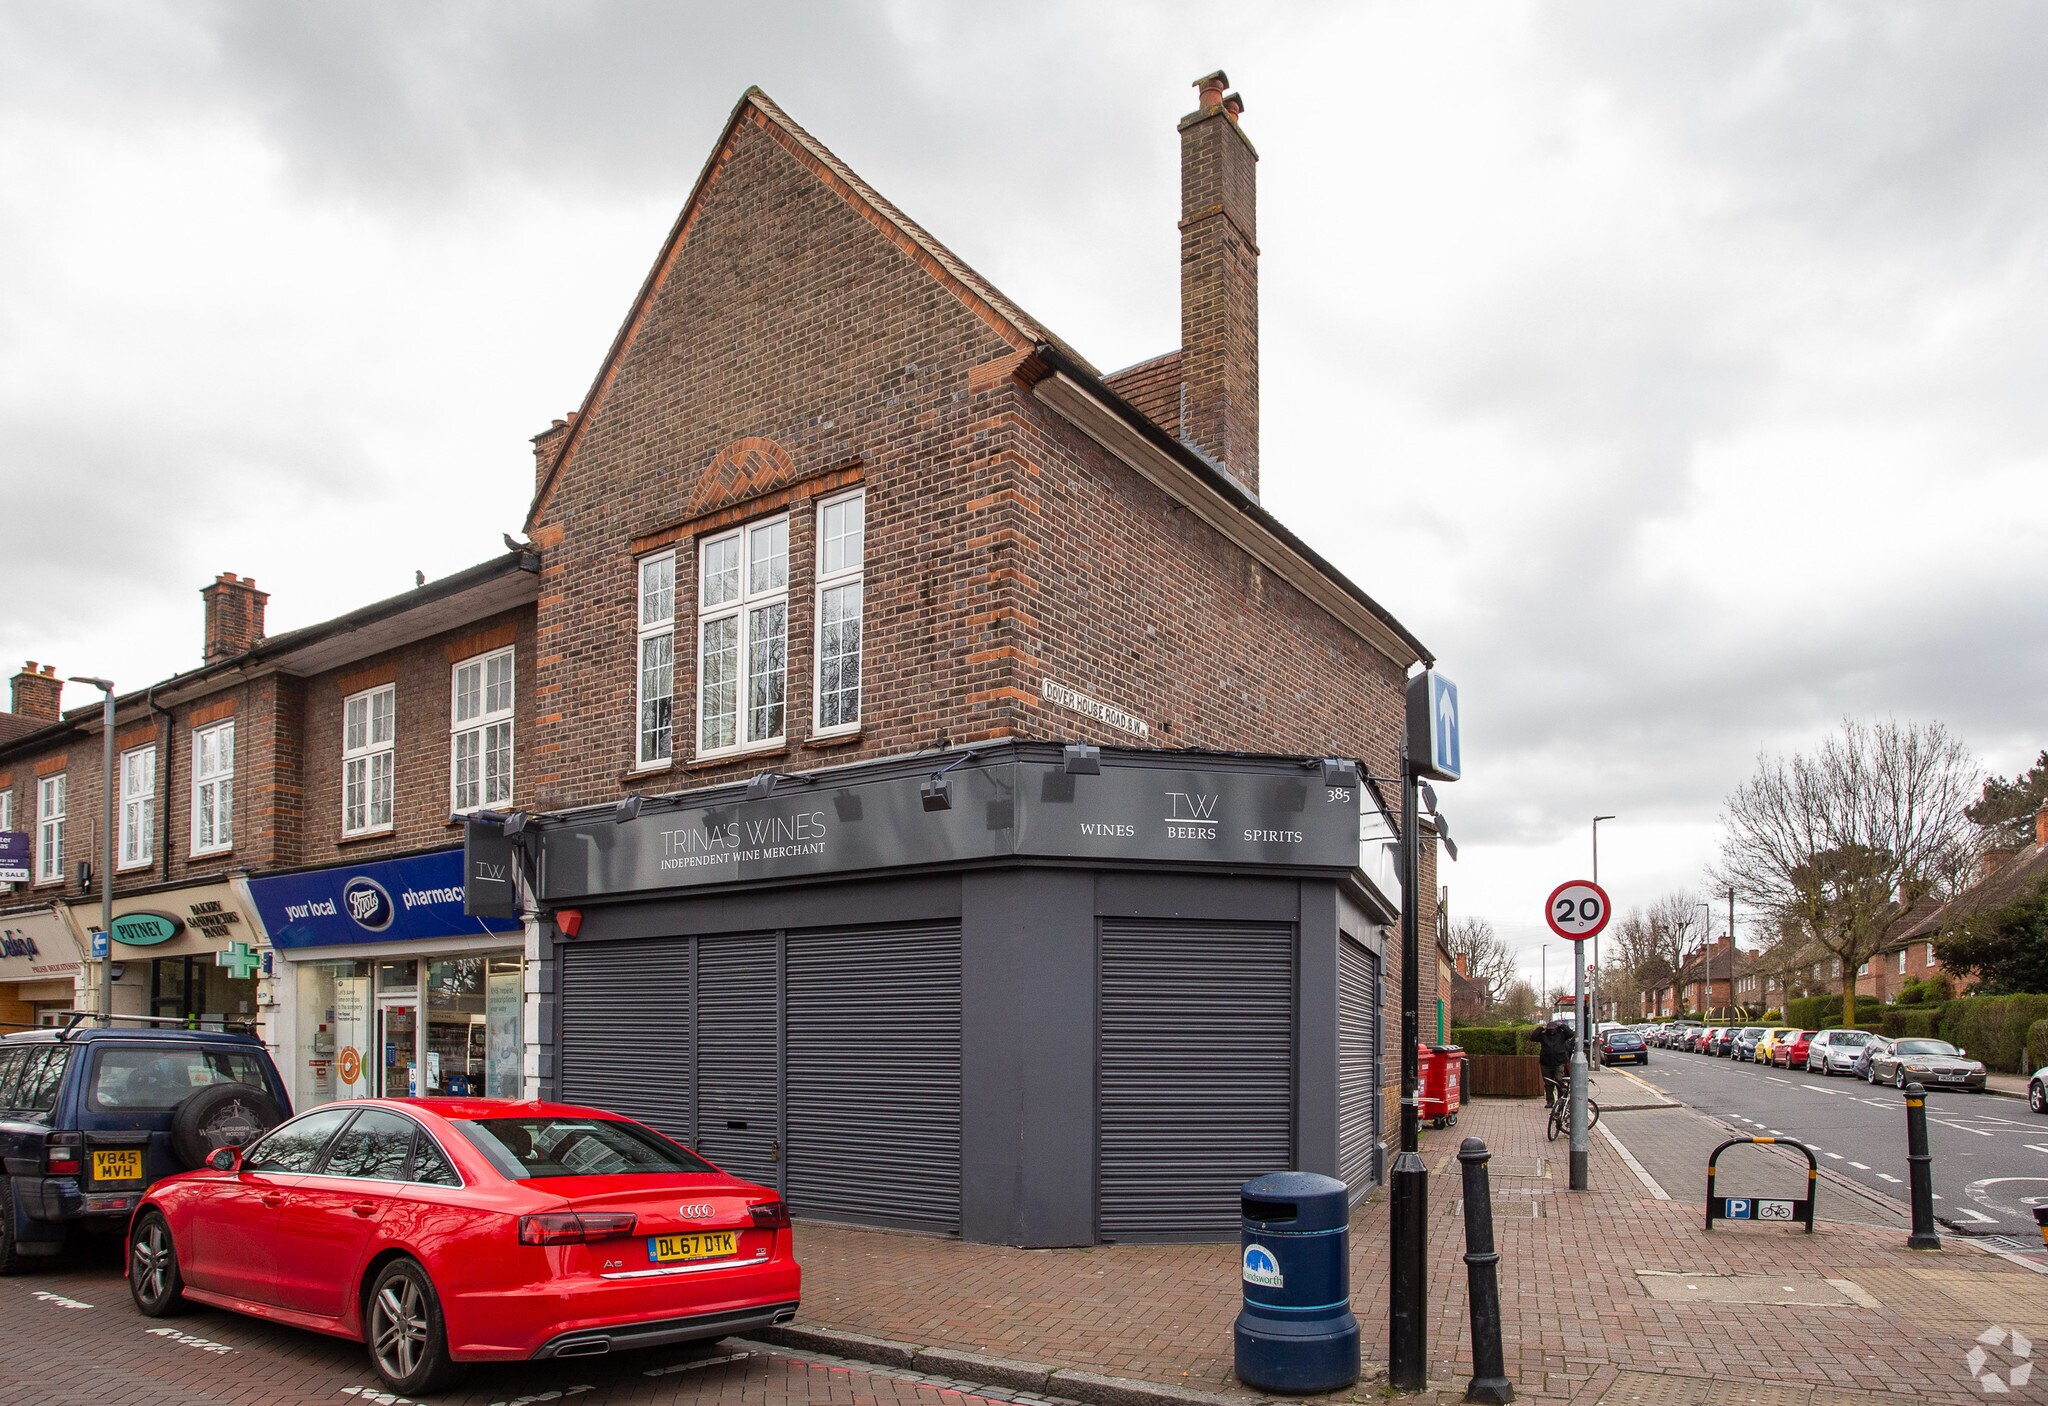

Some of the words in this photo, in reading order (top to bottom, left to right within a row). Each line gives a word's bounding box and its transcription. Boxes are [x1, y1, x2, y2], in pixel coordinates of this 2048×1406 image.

[1046, 683, 1074, 708] DOVER
[1076, 696, 1104, 719] HOUSE
[1327, 788, 1350, 803] 385
[1165, 792, 1219, 819] TW
[660, 822, 741, 855] TRINA'S
[745, 811, 826, 845] WINES
[1080, 823, 1135, 837] WINES
[1167, 826, 1216, 840] BEERS
[1244, 829, 1303, 843] SPIRITS
[661, 852, 730, 870] INDEPENDENT
[732, 849, 760, 862] WINE
[763, 842, 826, 859] MERCHANT
[476, 861, 506, 880] TW
[189, 900, 222, 915] BAKERY
[285, 903, 309, 922] your
[309, 898, 337, 917] local
[350, 889, 379, 919] Boots
[1556, 898, 1600, 922] 20
[186, 911, 240, 928] SANDWICHES
[116, 921, 164, 939] PUTNEY
[97, 1152, 137, 1165] V845
[102, 1165, 133, 1177] MVH
[1730, 1200, 1747, 1217] P
[659, 1236, 700, 1257] DL67
[704, 1234, 733, 1252] DTK
[603, 1259, 623, 1268] A6
